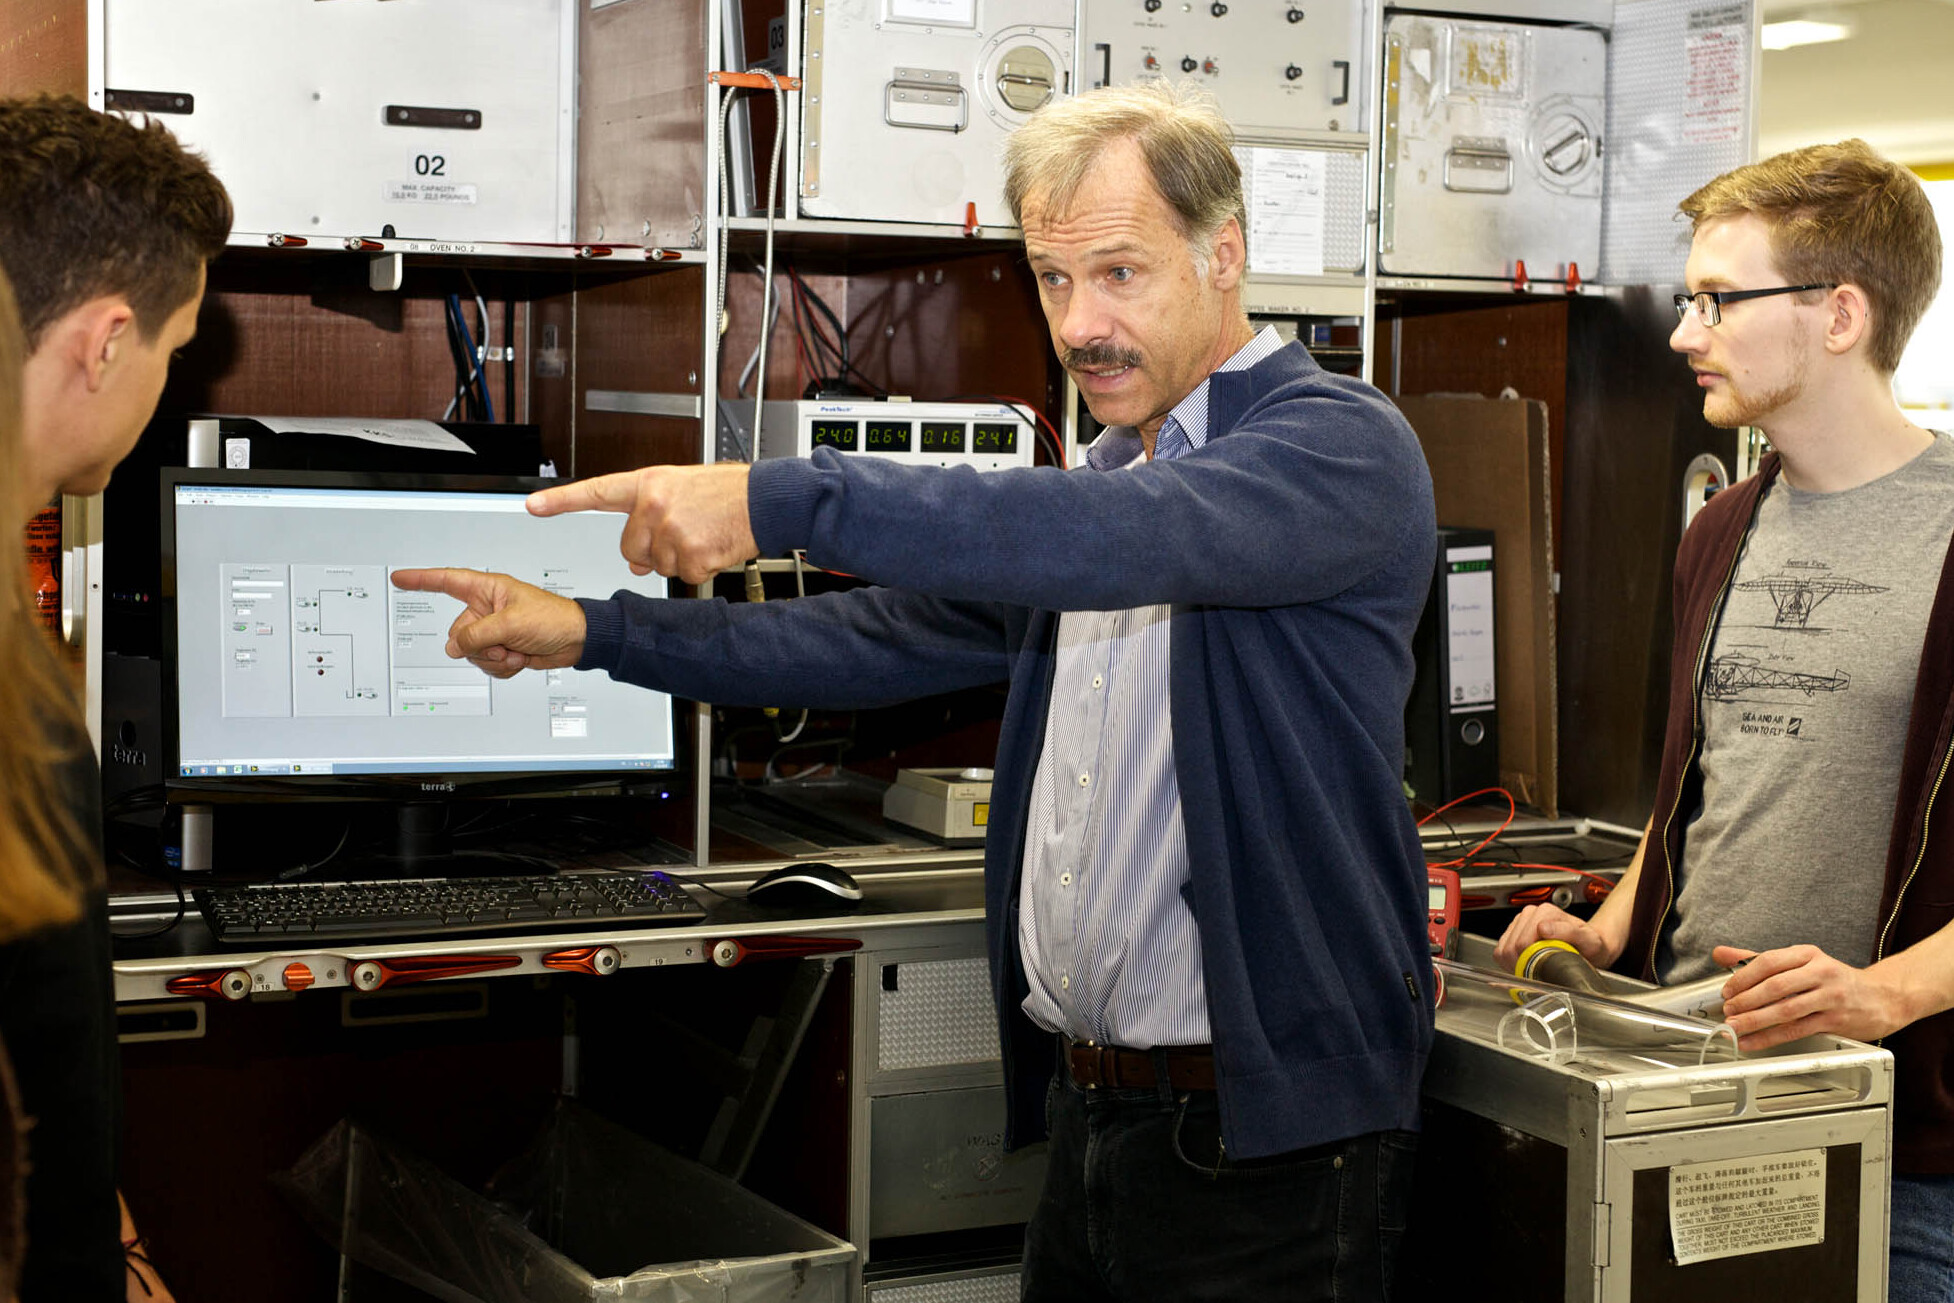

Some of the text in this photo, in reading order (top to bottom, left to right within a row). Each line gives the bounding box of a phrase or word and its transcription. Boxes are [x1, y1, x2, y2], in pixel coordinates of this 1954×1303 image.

[771, 25, 784, 49] 03
[415, 154, 446, 176] 02
[430, 243, 451, 252] OVEN
[815, 427, 853, 444] 24.0
[869, 428, 908, 444] 0.64
[924, 429, 961, 446] 0.16
[975, 430, 1014, 446] 24.1
[1742, 712, 1785, 723] SEA AND AIR
[1740, 724, 1759, 733] BORN
[1759, 726, 1770, 735] TO
[114, 743, 146, 766] terra
[421, 782, 445, 791] terra
